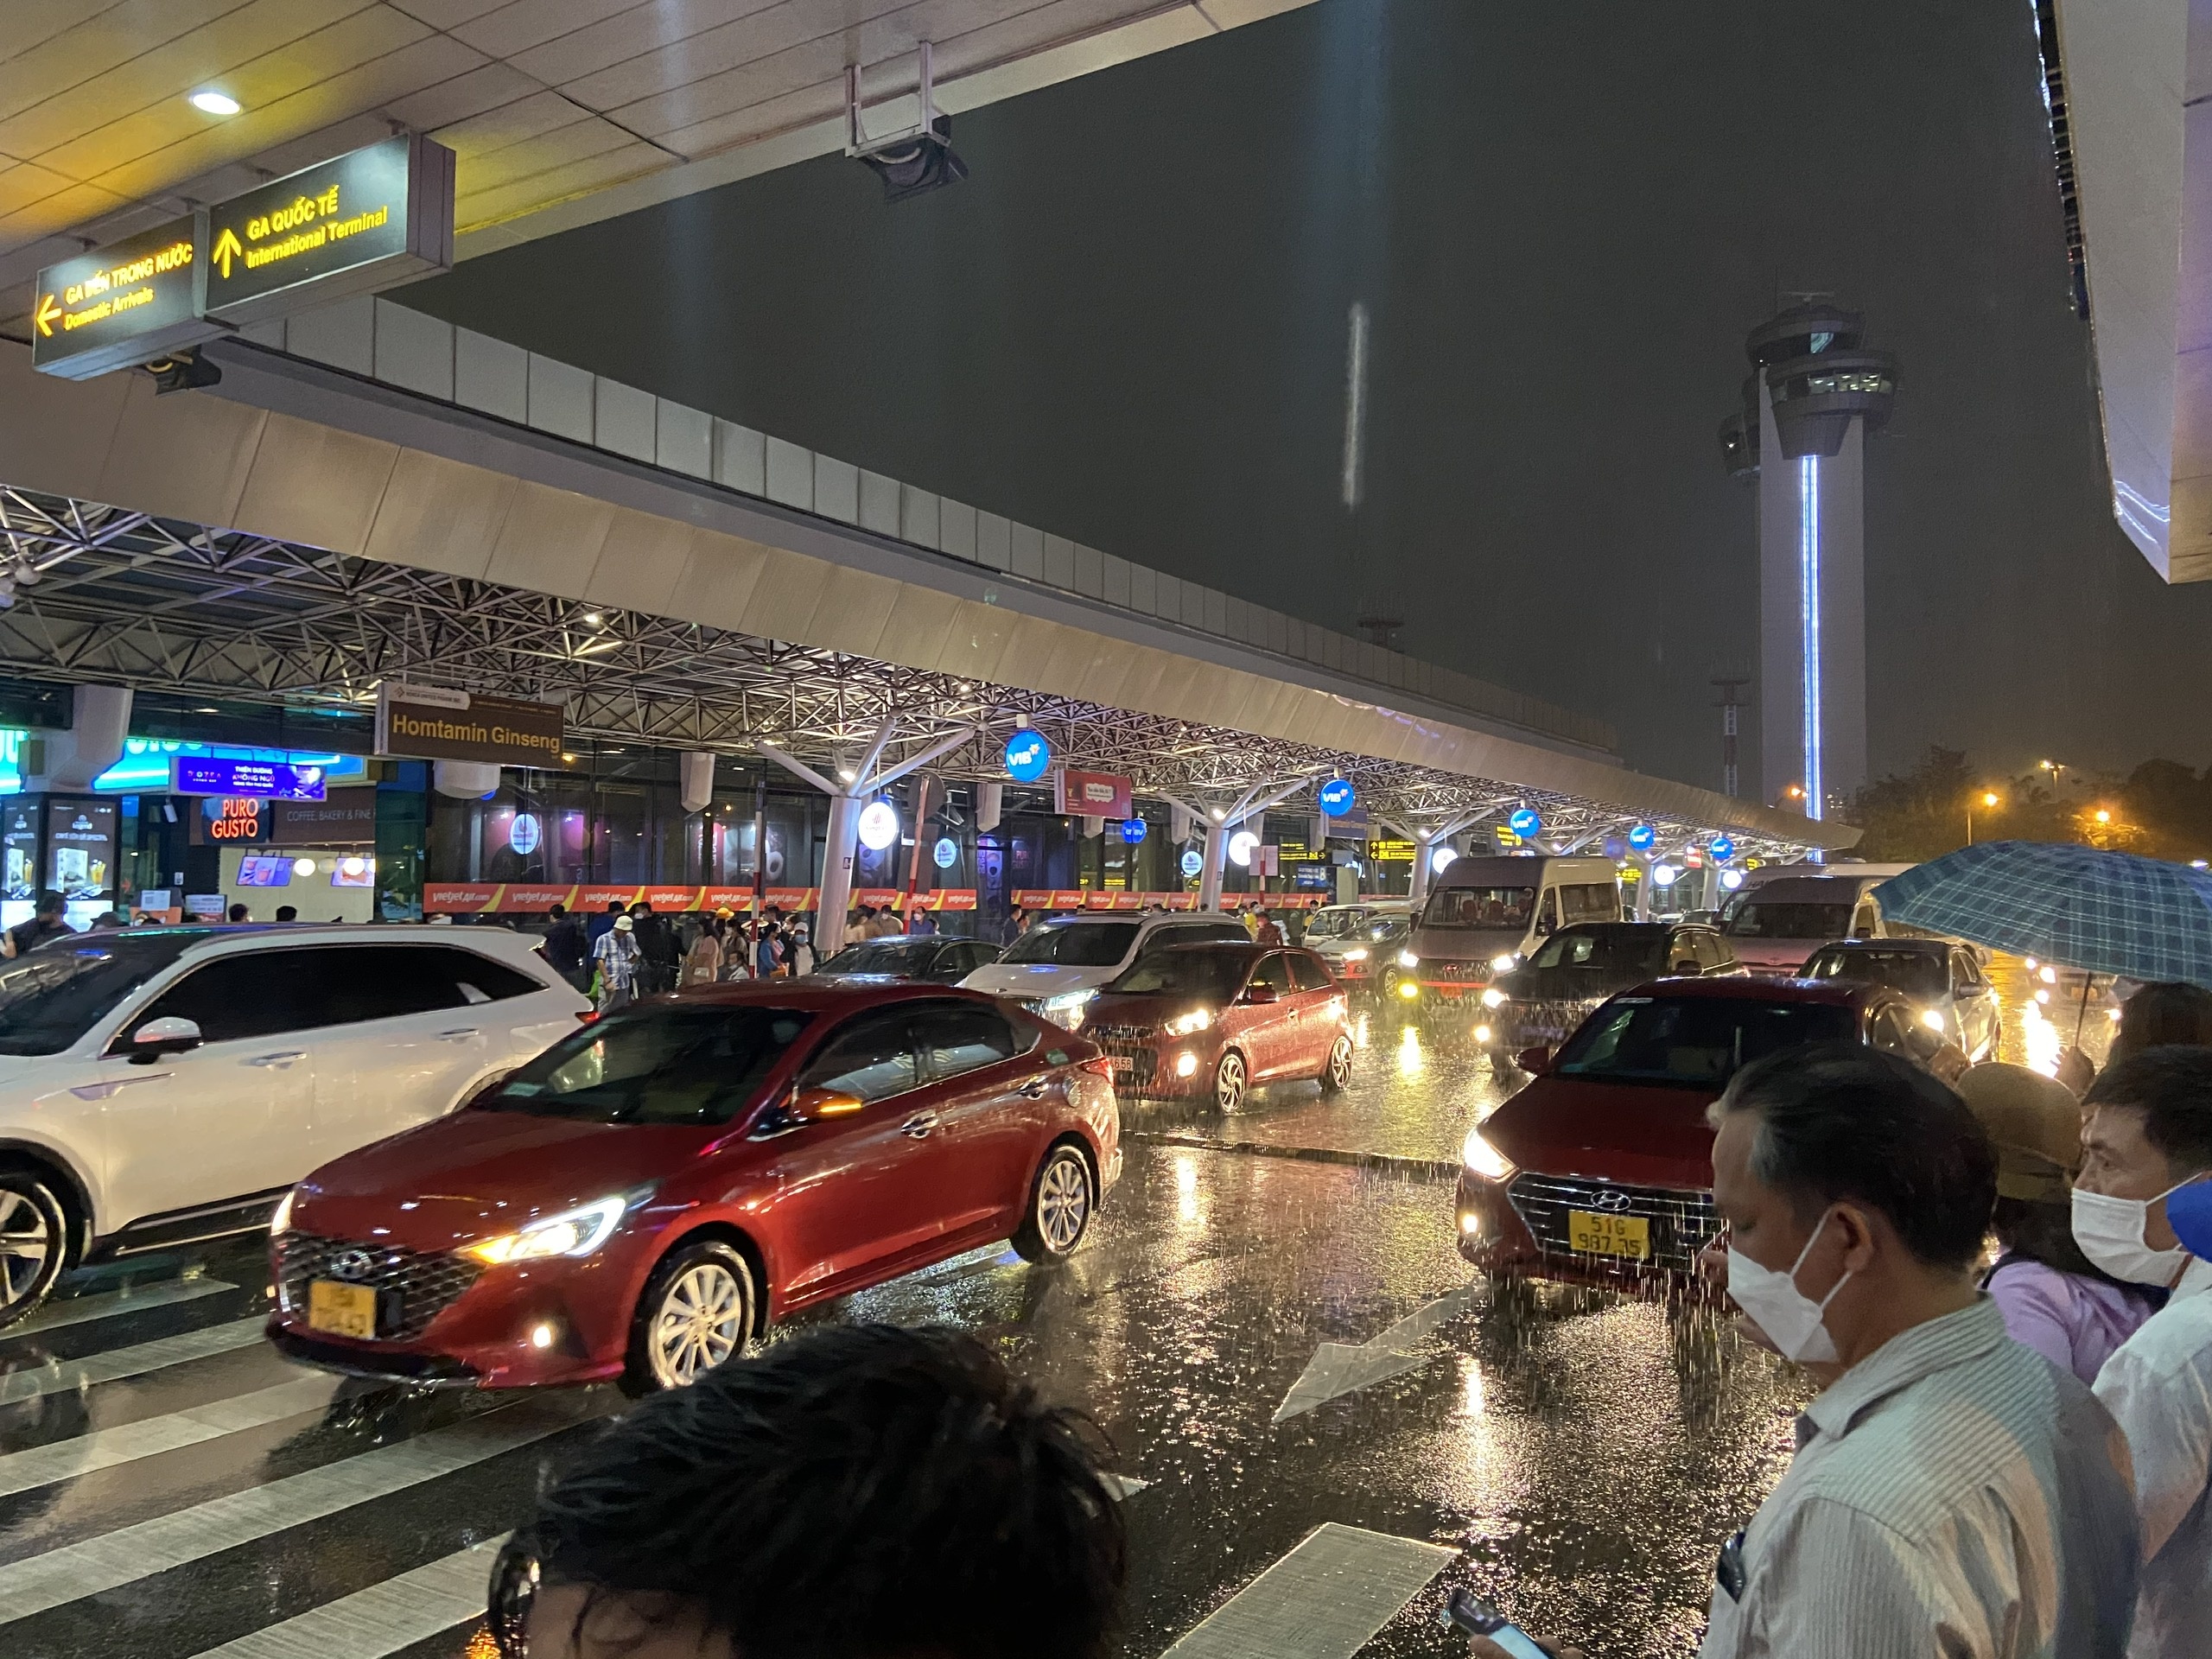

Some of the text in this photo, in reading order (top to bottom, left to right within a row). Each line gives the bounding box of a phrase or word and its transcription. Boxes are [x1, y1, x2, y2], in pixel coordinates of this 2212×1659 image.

[247, 184, 340, 240] GA QUỐC TẾ
[245, 205, 388, 269] International Terminal
[66, 285, 84, 305] GA
[112, 257, 155, 288] TRONG
[156, 243, 194, 273] NƯỚC
[64, 287, 154, 330] Domestic Arrivals
[393, 714, 560, 753] Homtamin Ginseng
[1008, 751, 1032, 766] VIB
[222, 798, 258, 817] PURO
[1323, 792, 1341, 803] VIB
[212, 818, 258, 838] GUSTO
[1591, 1216, 1626, 1236] 51G
